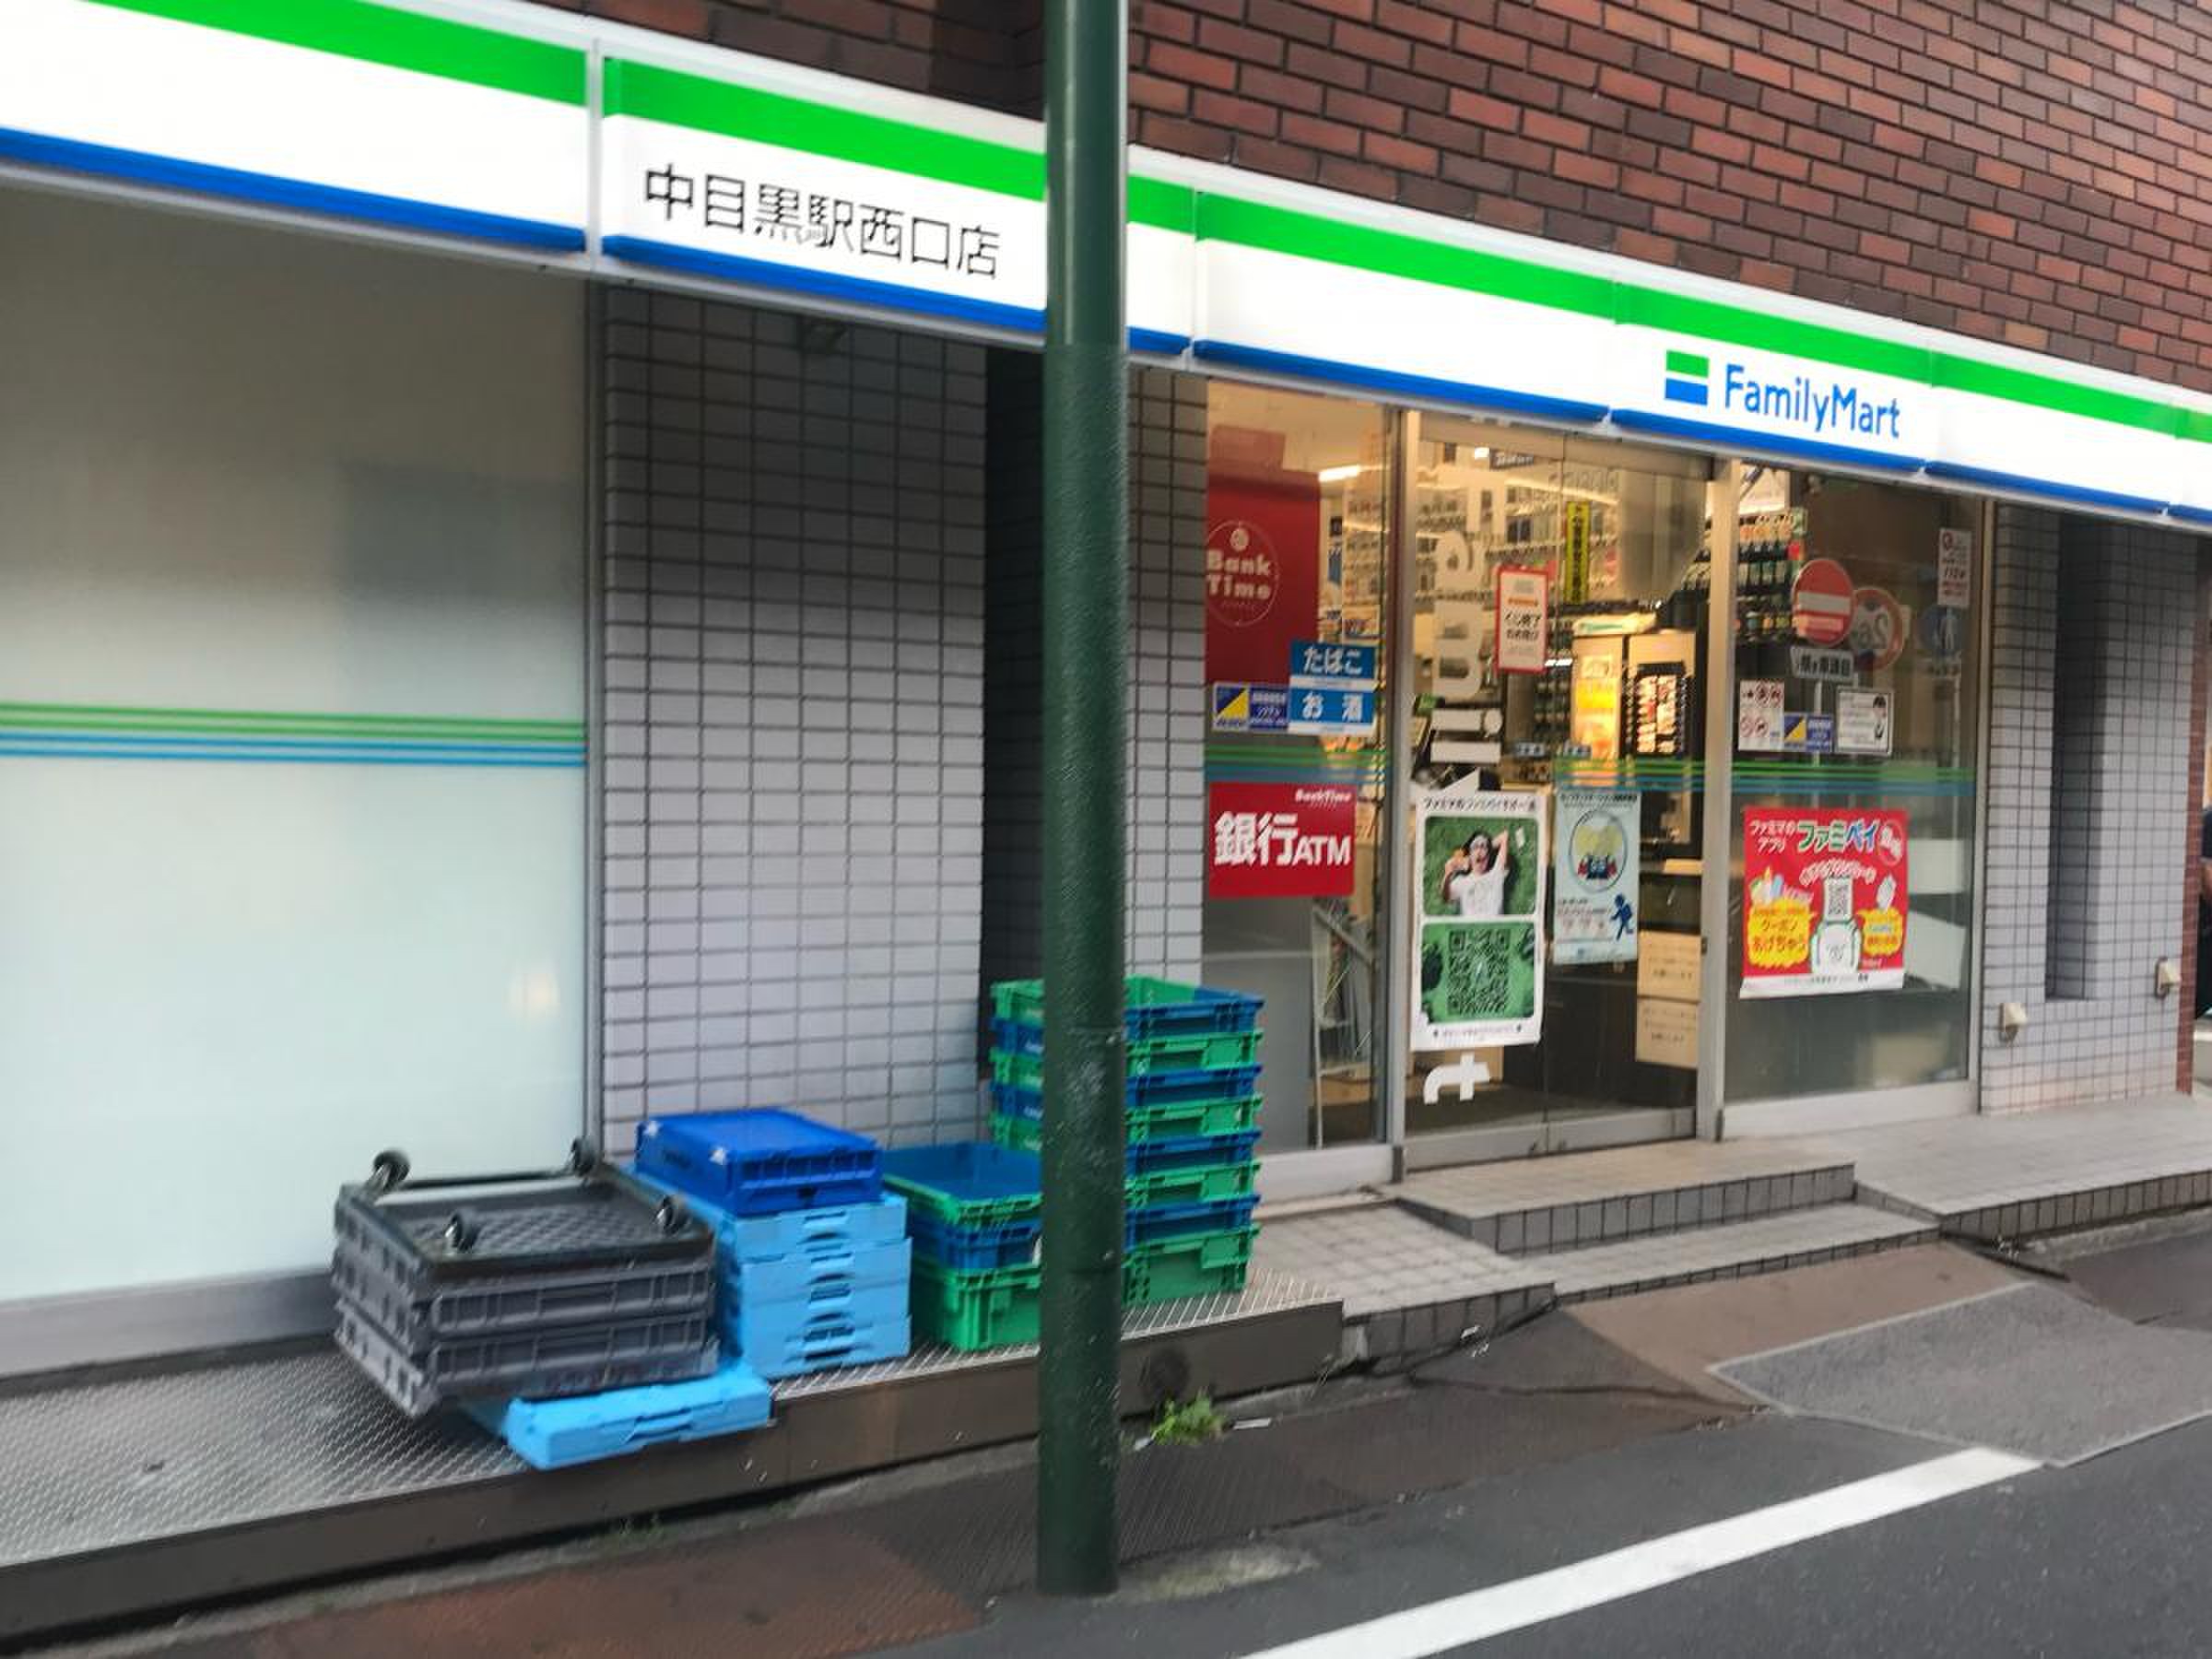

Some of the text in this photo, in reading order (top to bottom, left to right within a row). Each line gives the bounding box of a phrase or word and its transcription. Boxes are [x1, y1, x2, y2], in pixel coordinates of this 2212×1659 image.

[644, 162, 1000, 279] 中目黒駅西口店
[1725, 363, 1900, 439] FamilyMart
[1206, 549, 1271, 576] Bank
[1206, 574, 1271, 600] Time
[1303, 645, 1363, 675] たばこ
[1797, 818, 1880, 853] ファミペイ
